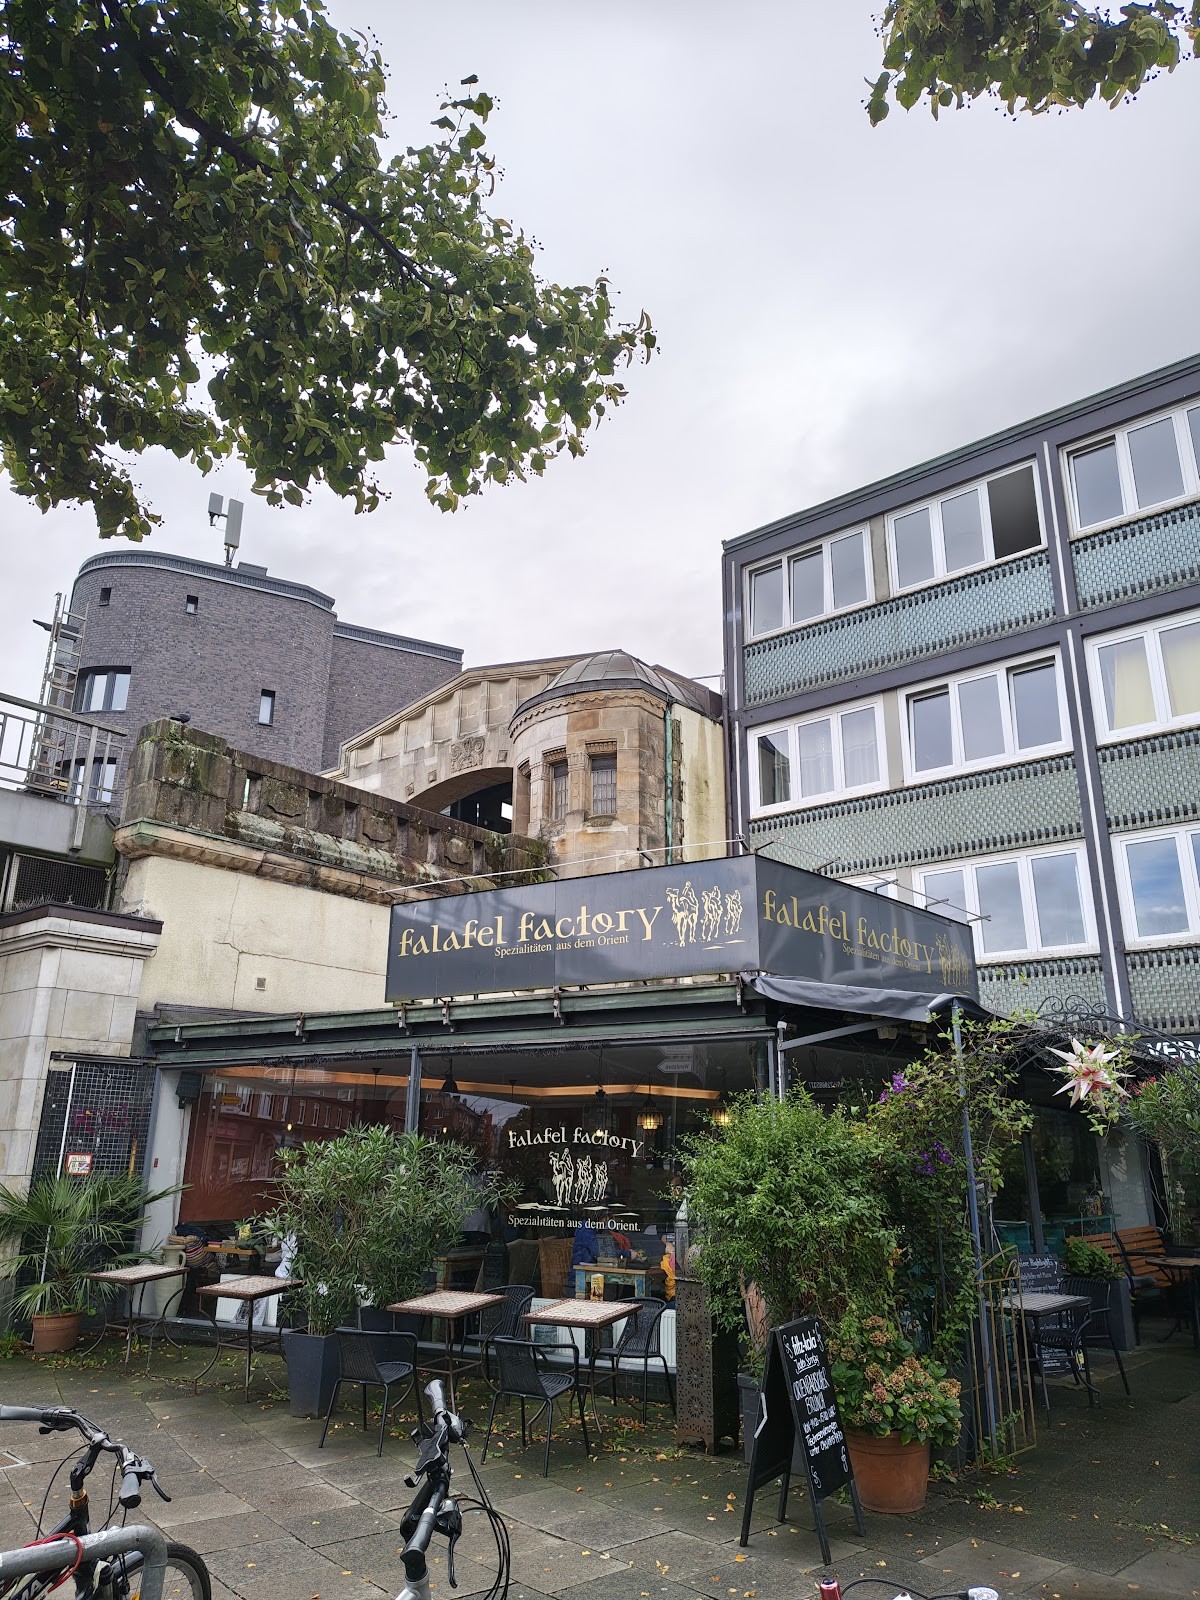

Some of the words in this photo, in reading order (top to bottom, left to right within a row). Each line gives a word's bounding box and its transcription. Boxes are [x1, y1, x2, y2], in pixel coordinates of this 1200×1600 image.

[398, 916, 507, 957] falafel
[517, 905, 664, 942] factory
[763, 890, 850, 942] falafel
[857, 917, 935, 974] factory
[494, 942, 552, 958] Spezialitäten
[556, 940, 571, 950] aus
[574, 936, 595, 949] dem
[597, 934, 629, 946] Orient
[842, 942, 880, 961] Spezialitäten
[508, 1127, 567, 1148] falafel
[572, 1127, 645, 1158] factory
[508, 1214, 564, 1228] Spezialitäten
[567, 1221, 582, 1229] aus
[584, 1218, 605, 1230] dem
[608, 1219, 641, 1232] Orient.
